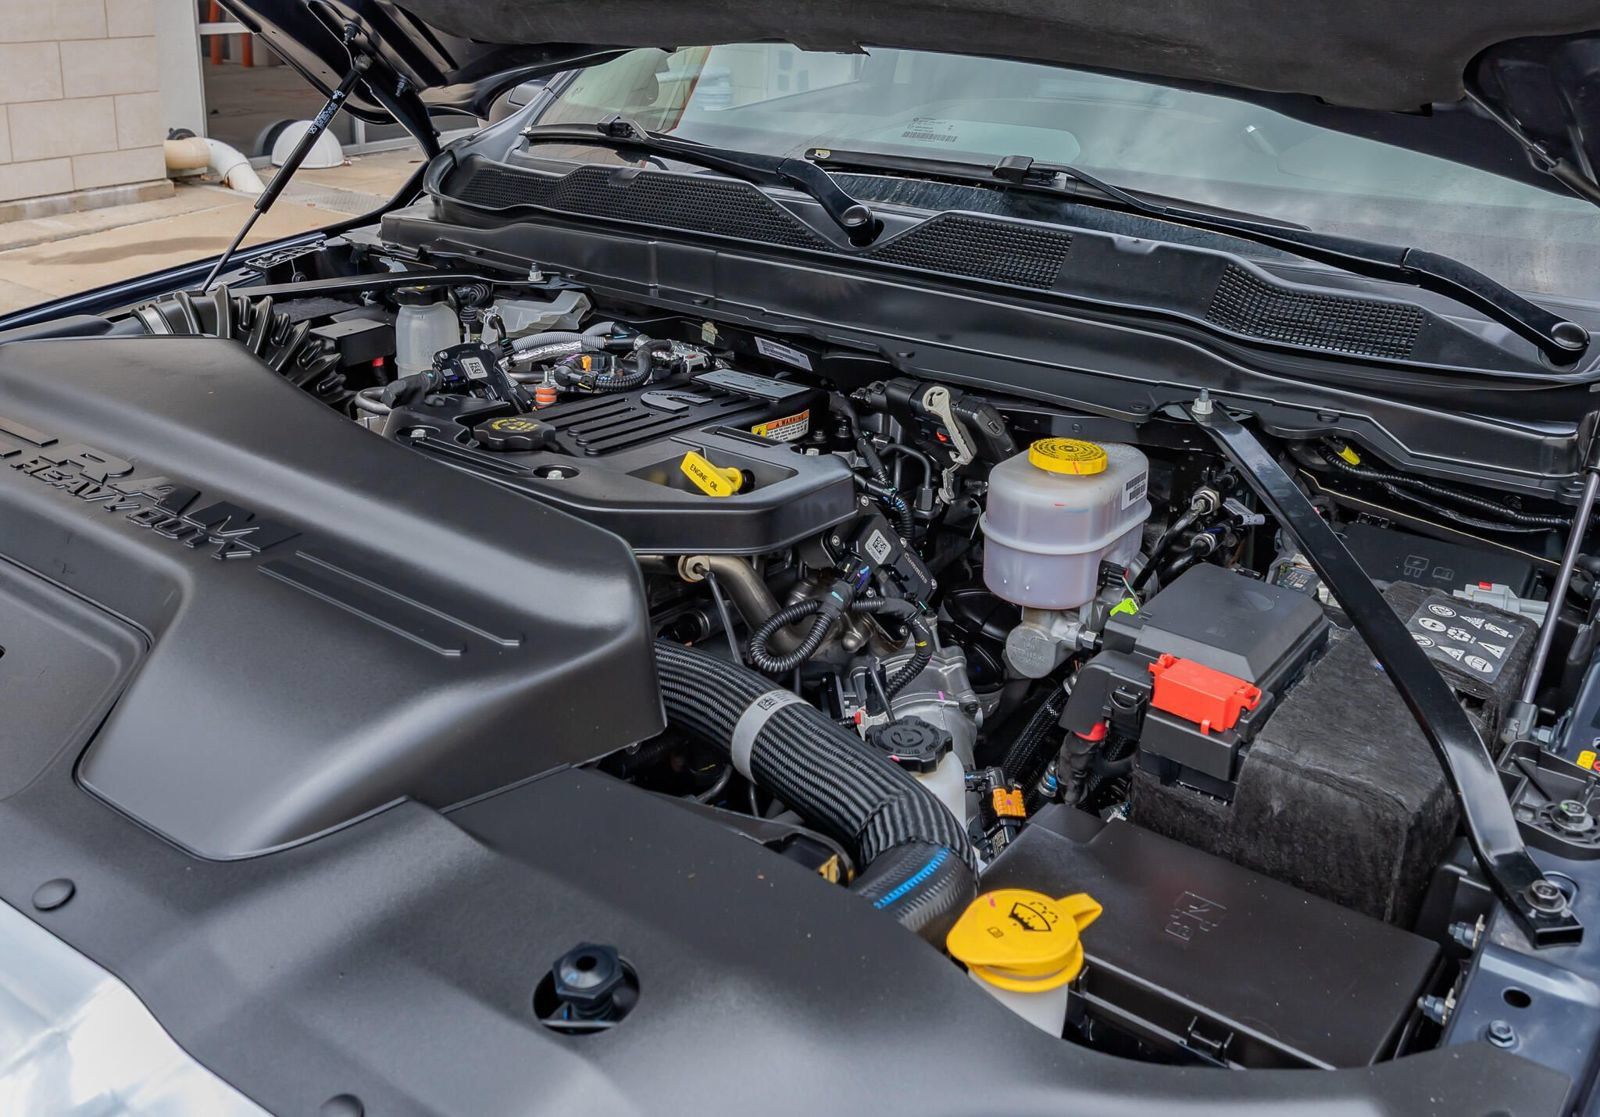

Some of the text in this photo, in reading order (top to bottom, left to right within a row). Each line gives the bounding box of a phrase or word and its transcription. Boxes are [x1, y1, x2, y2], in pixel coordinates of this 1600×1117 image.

[10, 454, 252, 560] HEAVY DUTY
[38, 442, 304, 552] RAM
[689, 463, 719, 493] ENGINE OIL
[904, 552, 928, 584] Cummins
